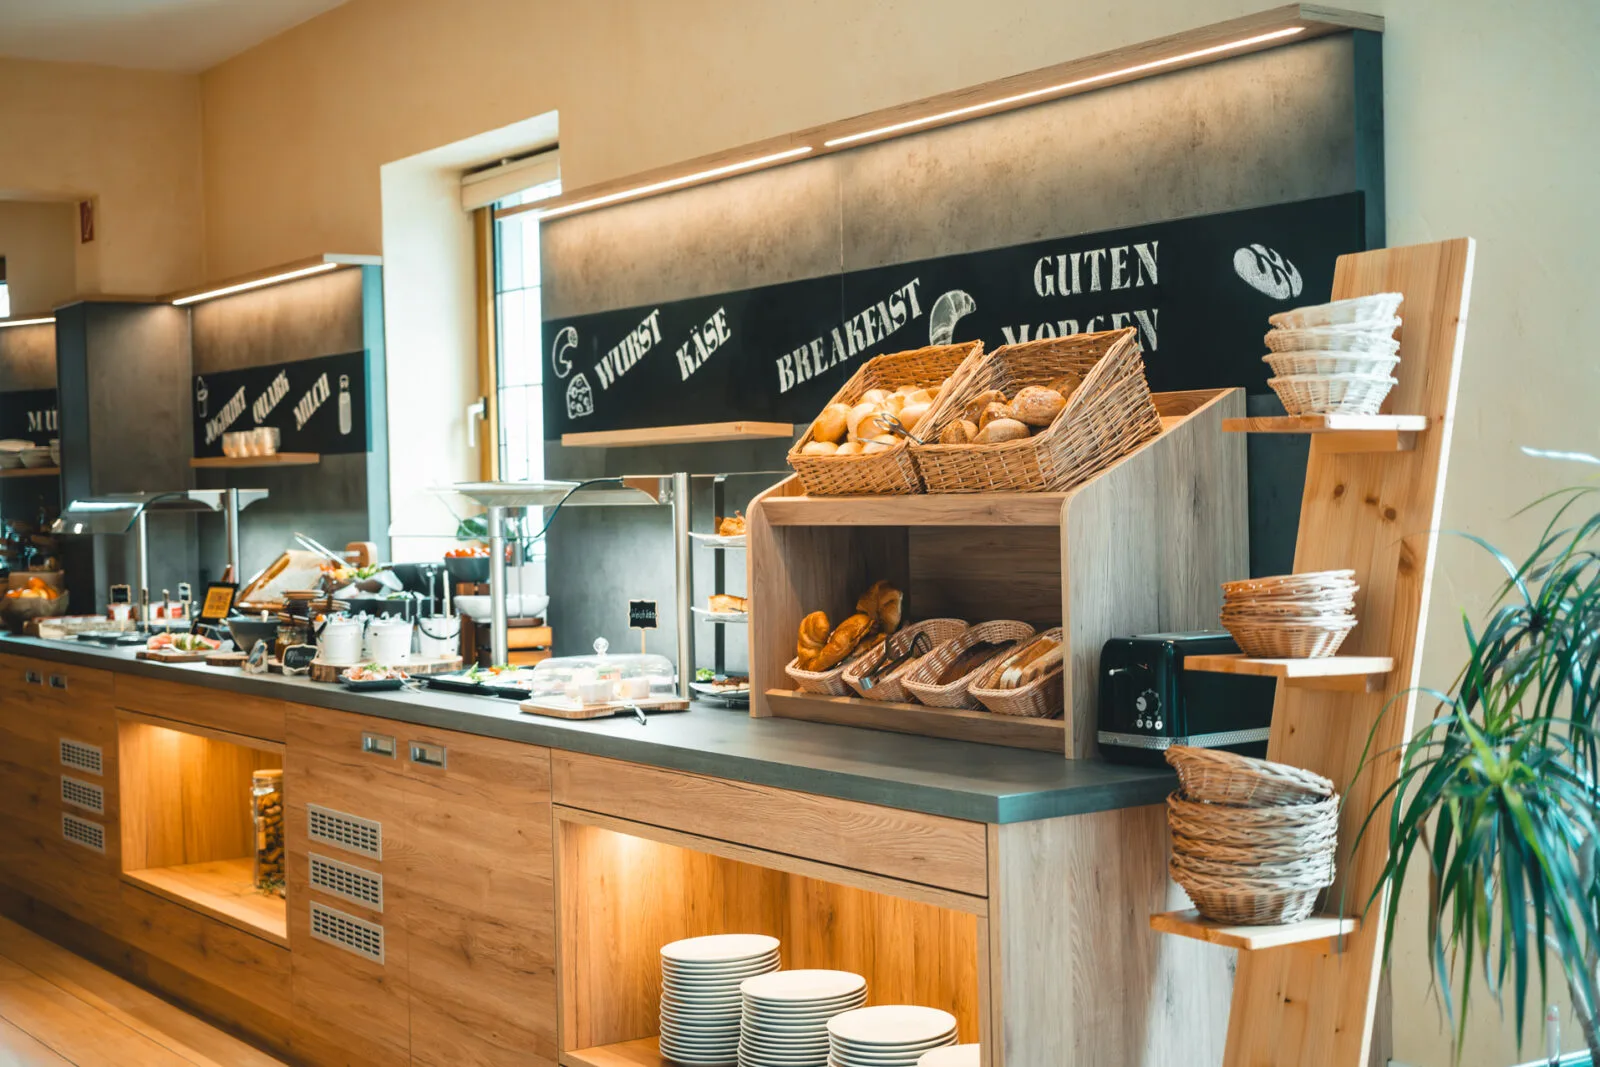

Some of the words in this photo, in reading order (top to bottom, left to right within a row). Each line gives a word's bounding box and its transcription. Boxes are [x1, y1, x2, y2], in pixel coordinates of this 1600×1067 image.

[1033, 240, 1159, 297] GUTEN
[594, 308, 662, 390] WURST
[675, 306, 731, 382] KÄSE
[775, 277, 923, 394] BREAKFAST
[252, 369, 290, 424] QUARK
[293, 372, 331, 431] MILCH
